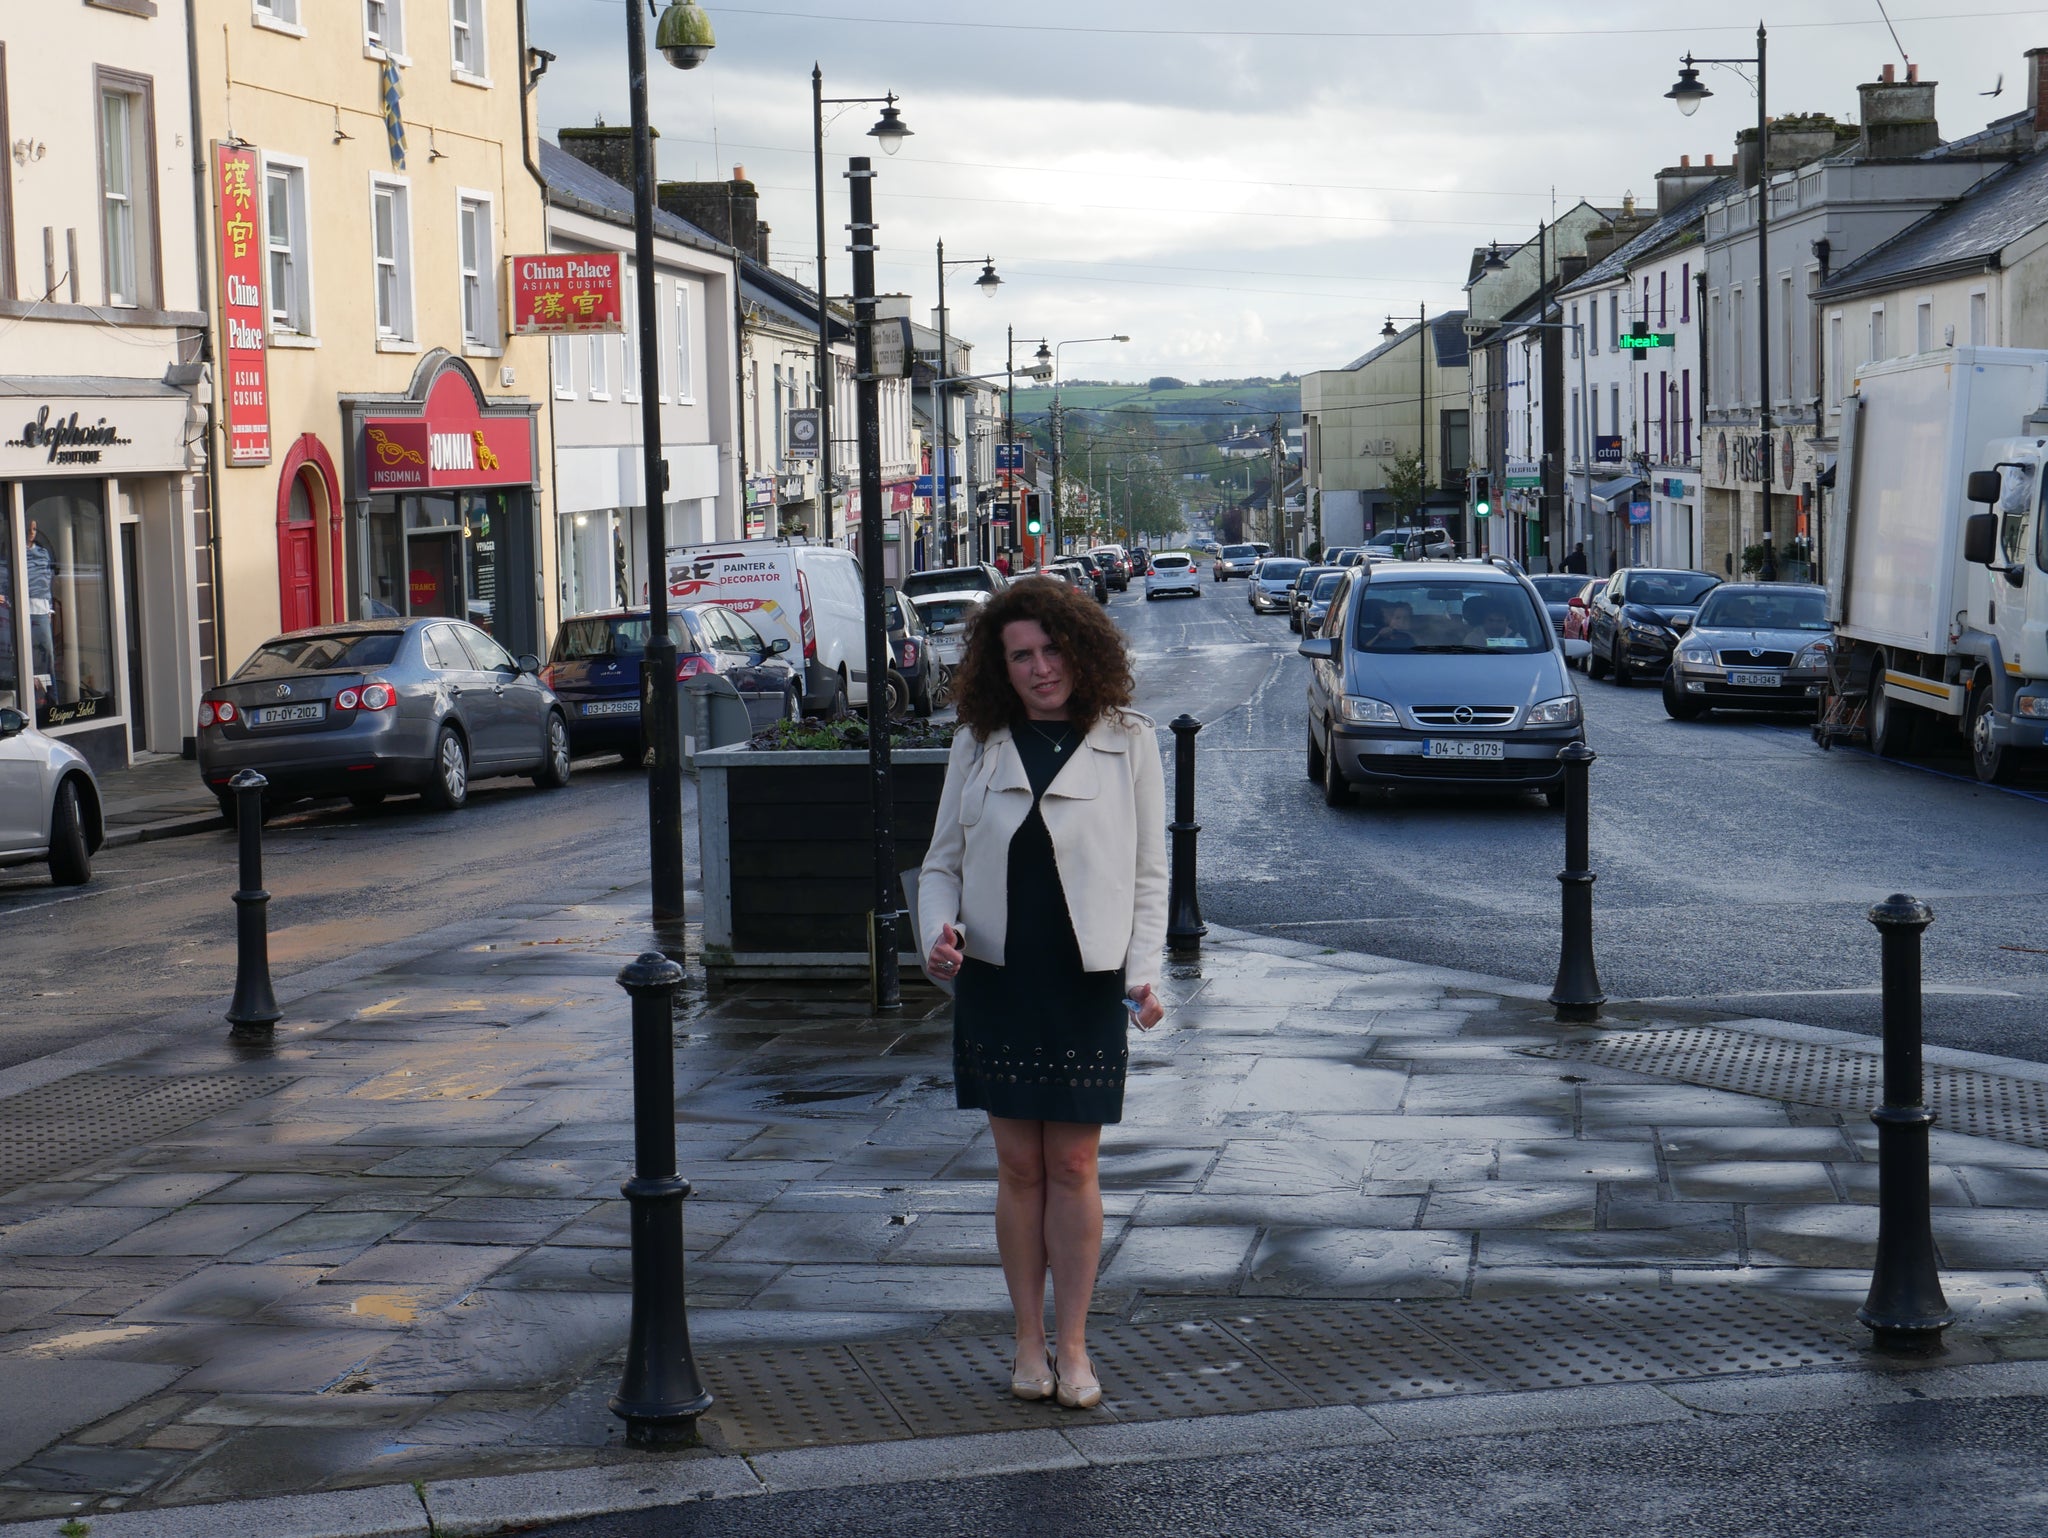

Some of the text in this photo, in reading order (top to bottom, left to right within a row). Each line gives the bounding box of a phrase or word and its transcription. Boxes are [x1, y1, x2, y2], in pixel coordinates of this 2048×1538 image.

[523, 261, 611, 280] China Palace
[227, 274, 259, 307] China
[523, 280, 613, 291] ASIAN CUSINE
[228, 318, 262, 350] Palace
[235, 371, 260, 387] ASIAN
[233, 391, 263, 406] CUSINE
[1360, 438, 1396, 456] AIB
[1598, 446, 1620, 458] atm
[56, 450, 102, 465] BOUTIQUE
[374, 470, 421, 483] INSOMNIA
[1508, 466, 1538, 474] FUJIFILM
[723, 561, 776, 573] PAINTER &
[720, 573, 780, 585] DECORATOR
[723, 601, 755, 611] 91867
[49, 700, 96, 725] Designer Labels
[266, 706, 317, 721] 07-OY-2102
[588, 702, 639, 714] 03-D-29962
[1434, 742, 1498, 756] 04-C-8179
